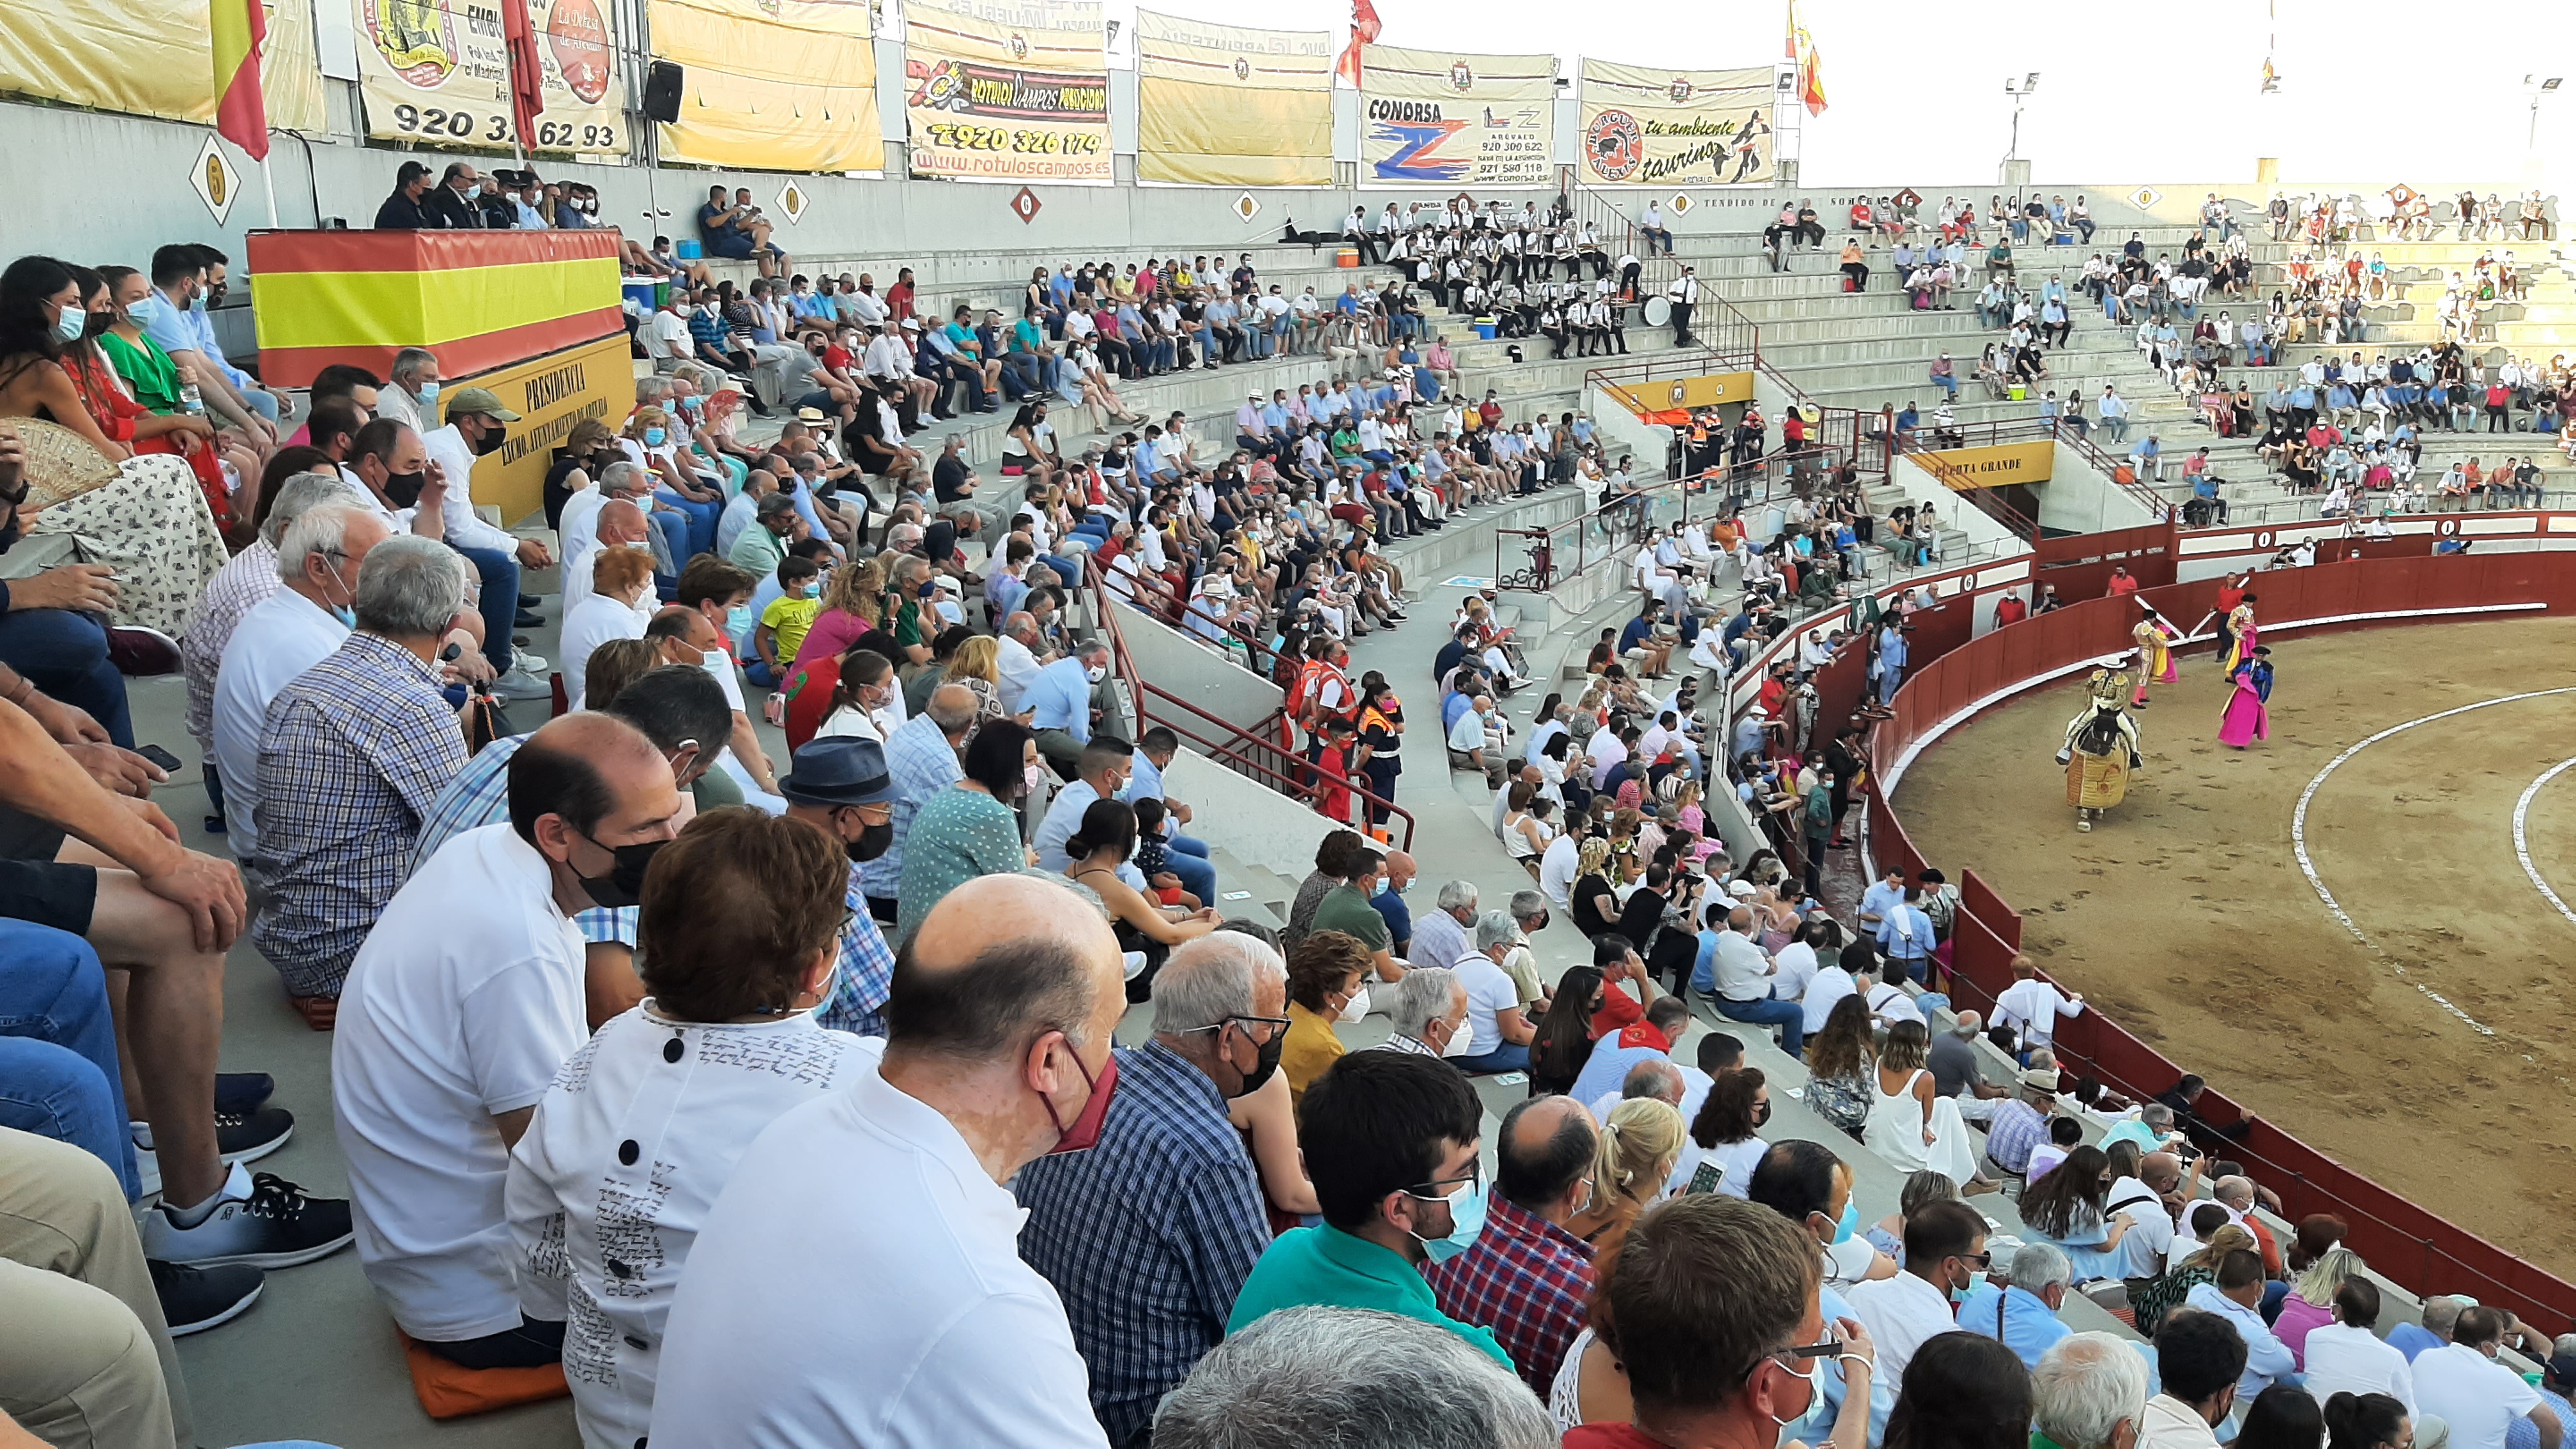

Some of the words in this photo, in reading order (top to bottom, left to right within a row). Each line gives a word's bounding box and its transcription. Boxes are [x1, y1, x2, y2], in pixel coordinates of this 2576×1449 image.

[1013, 73, 1058, 111] CAMPOS
[394, 104, 473, 136] 920
[1368, 98, 1443, 123] CONORSA
[540, 122, 573, 146] 62
[583, 125, 614, 147] 93
[1644, 118, 1666, 135] tu
[1667, 115, 1736, 136] ambiente
[952, 125, 1008, 150] 920
[1014, 130, 1059, 153] 326
[1064, 132, 1101, 155] 174
[1482, 142, 1501, 151] 920
[1504, 142, 1522, 151] 300
[1525, 142, 1543, 151] 622
[916, 153, 1110, 178] www.rotuloscampos.es
[1480, 164, 1498, 173] 921
[1591, 158, 1637, 180] ALEXIS
[1641, 141, 1716, 183] taurino
[1704, 199, 1755, 207] TENDIDO
[1762, 198, 1775, 206] DE
[525, 362, 586, 414] PRESIDENCIA
[501, 433, 530, 466] EXCMO.
[1981, 458, 2022, 472] GRANDE
